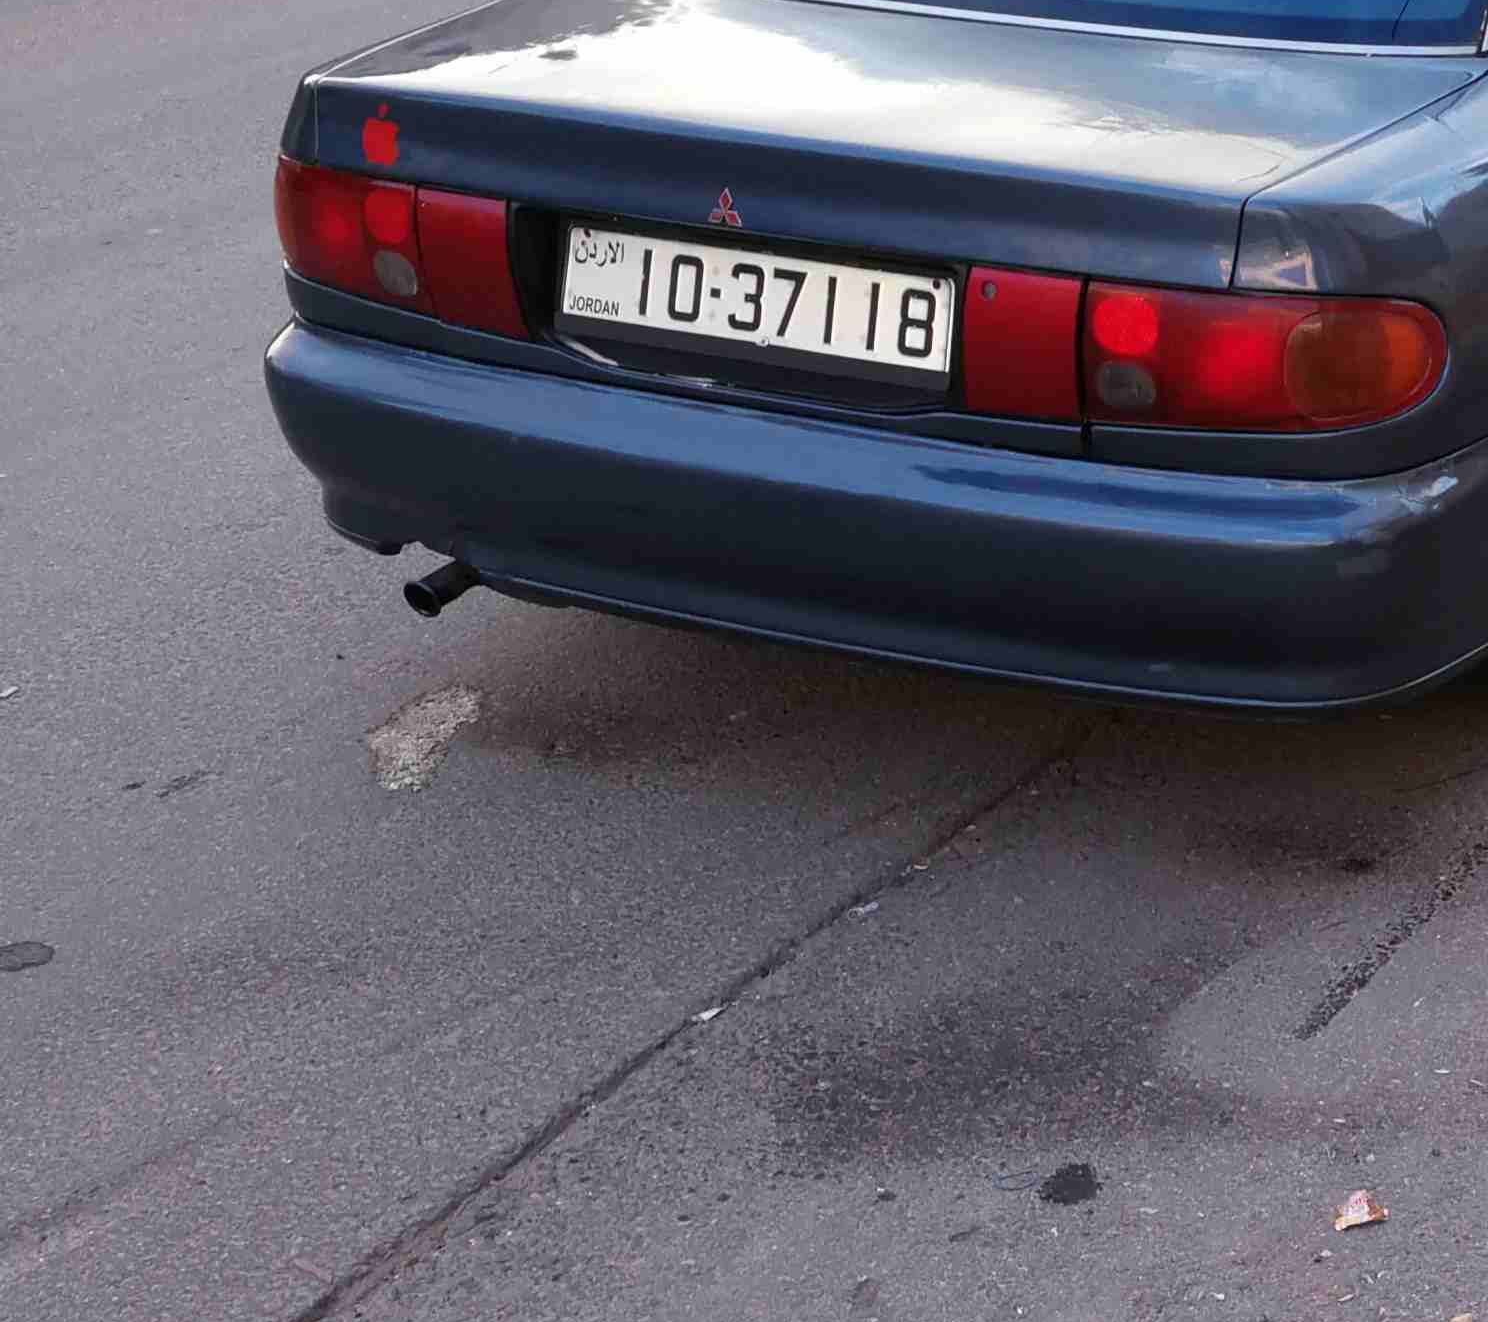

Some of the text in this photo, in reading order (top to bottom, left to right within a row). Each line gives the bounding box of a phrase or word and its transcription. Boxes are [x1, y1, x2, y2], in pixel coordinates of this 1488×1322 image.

[574, 239, 625, 268] الاردن
[569, 294, 620, 318] JORDAN
[637, 248, 937, 359] 10-37118
